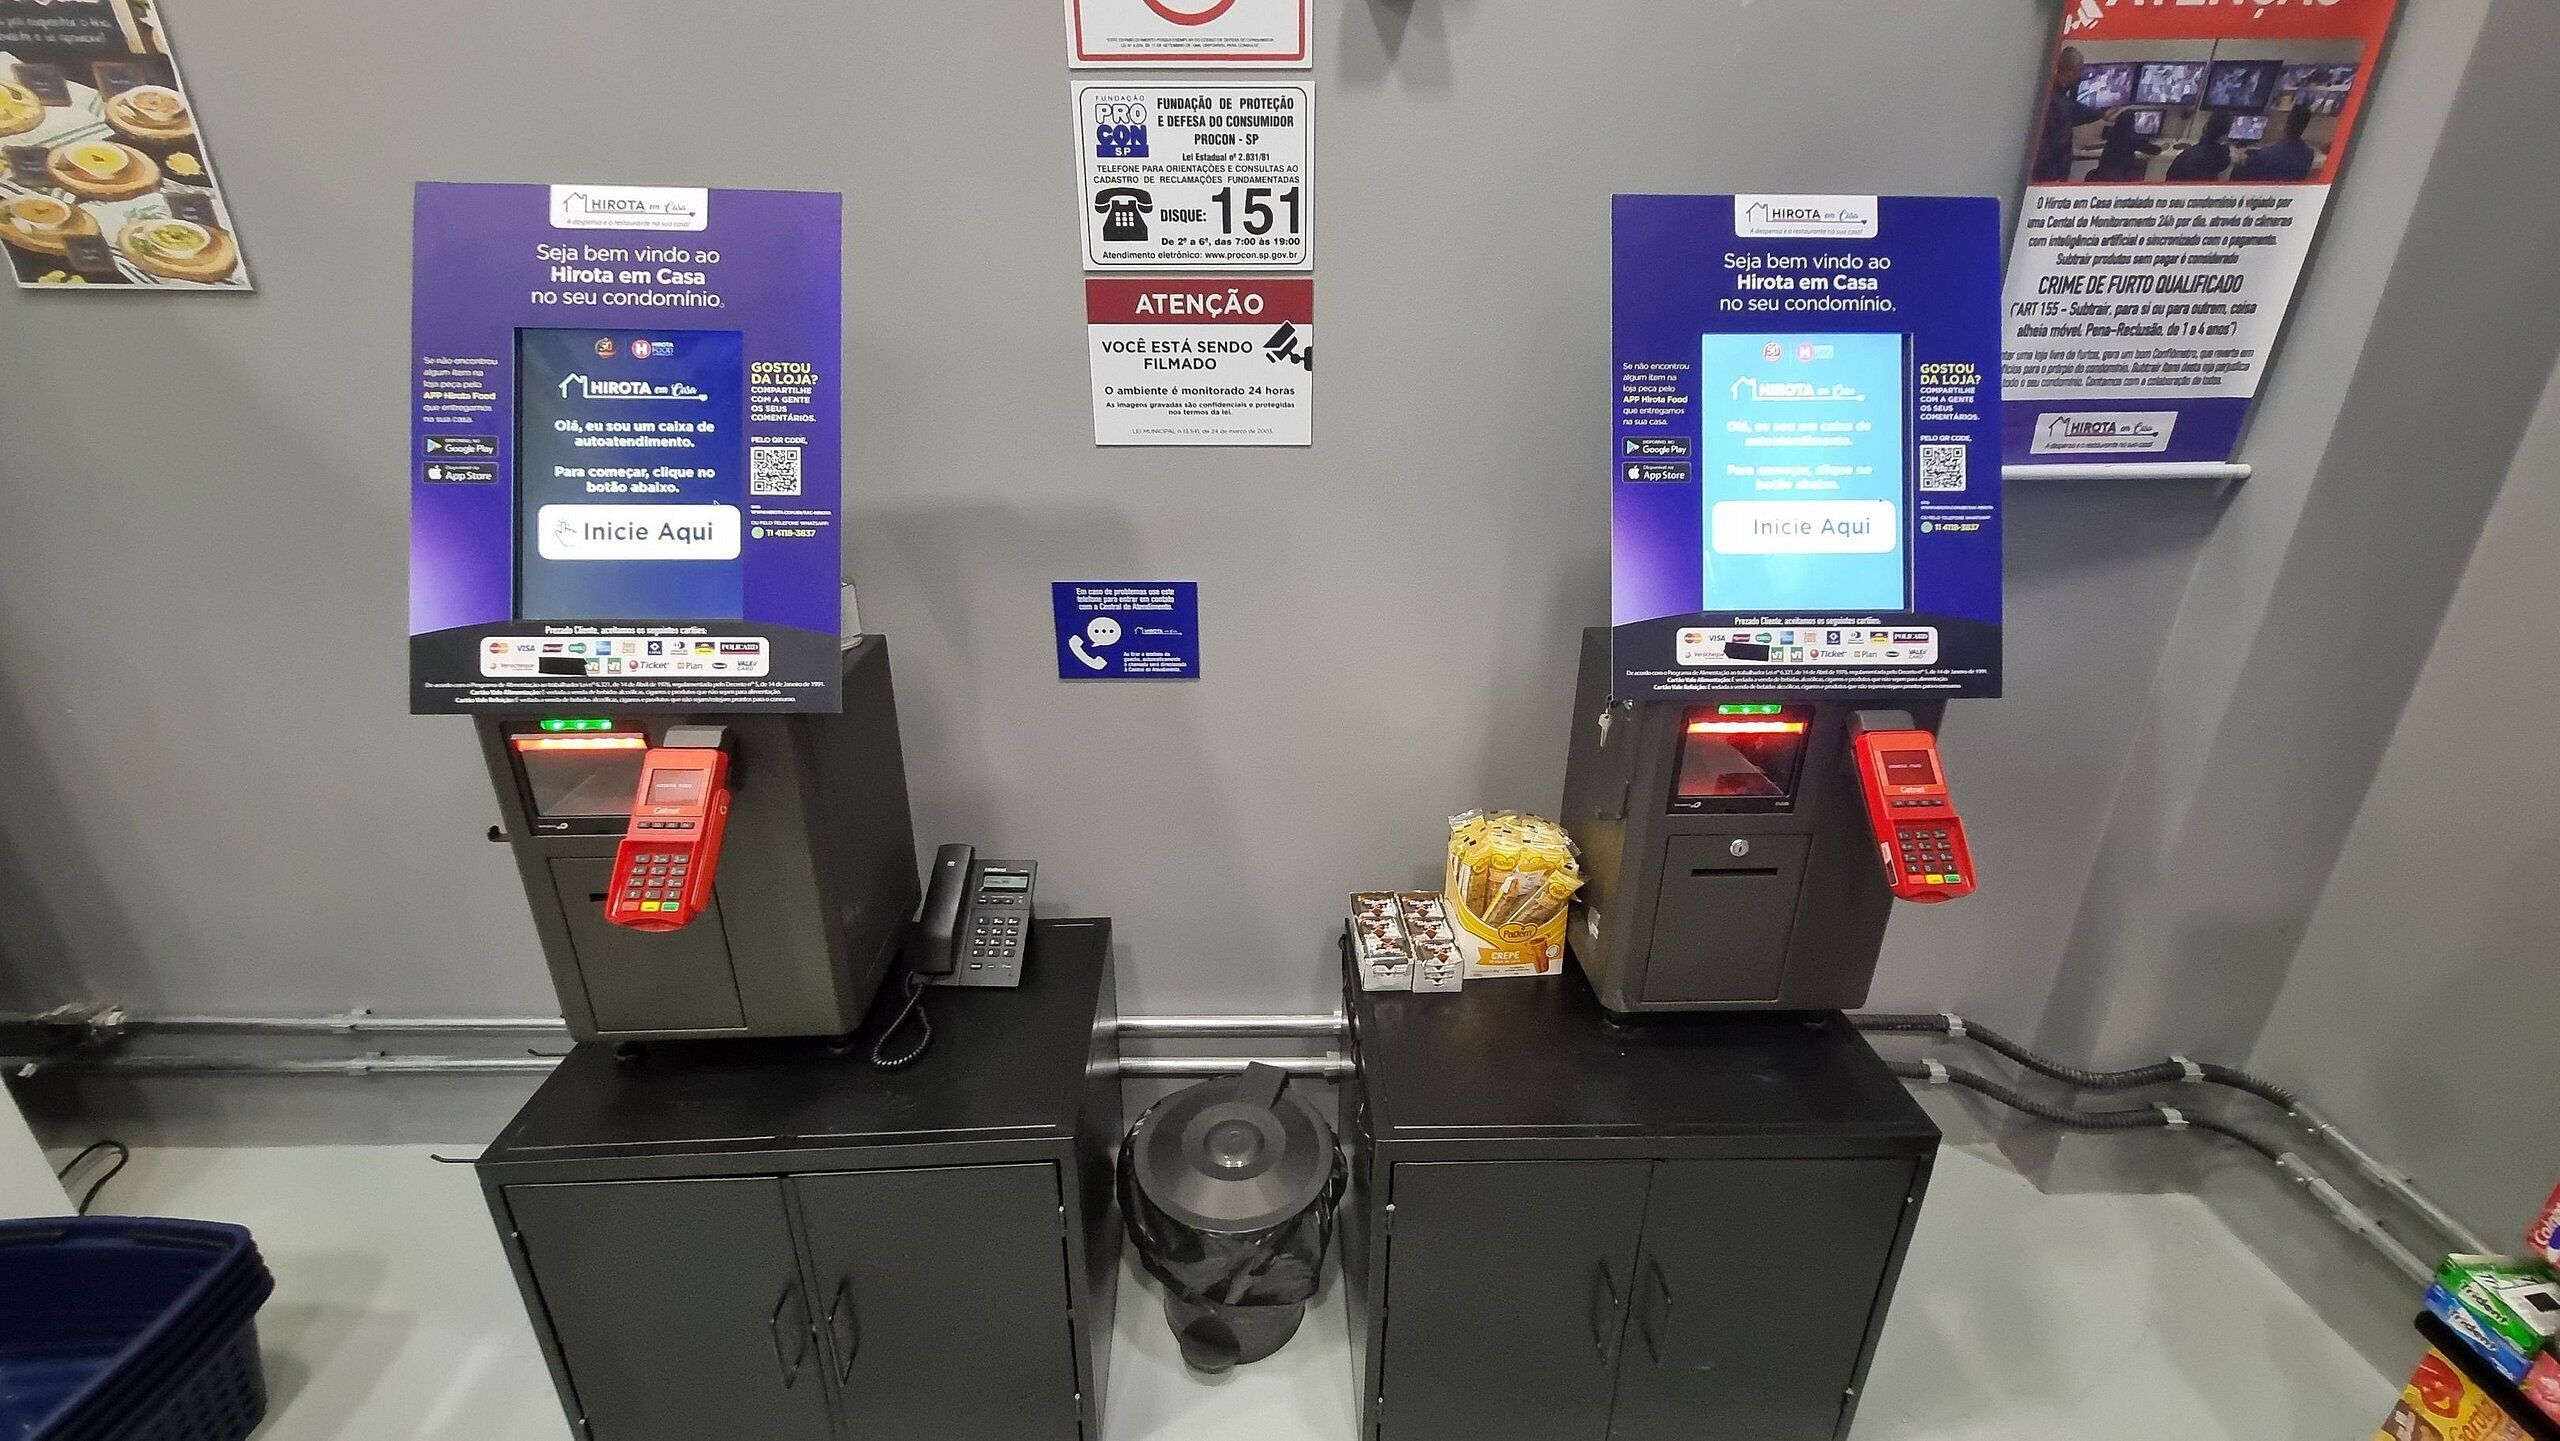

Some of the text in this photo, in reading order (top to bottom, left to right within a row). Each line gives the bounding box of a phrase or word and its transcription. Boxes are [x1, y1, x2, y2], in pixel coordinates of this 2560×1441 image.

[1095, 94, 1145, 102] FUNDAÇÃO
[1157, 95, 1294, 113] FUNDAÇÃO DE PROTEÇÃO
[1095, 103, 1147, 125] PRO
[1158, 116, 1294, 128] E DEFESA DO CONSUMIDOR
[1097, 124, 1147, 145] CON
[1194, 134, 1259, 146] PROCON SP
[1115, 147, 1131, 156] SP
[1182, 153, 1194, 162] Lei
[1195, 153, 1227, 162] Estadual
[1097, 163, 1299, 175] TELEFONE PARA ORIENTAÇÕES E CONSULTAS AO
[1093, 174, 1300, 185] CADASTRO DE RECLAMAÇÕES FUNDAMENTADAS
[592, 199, 645, 211] HIROTA
[664, 201, 687, 213] Casa
[1212, 187, 1299, 235] 151
[1160, 209, 1207, 223] DISQUE:
[1772, 208, 1821, 219] HIROTA
[1161, 237, 1175, 246] De
[1214, 237, 1232, 246] das
[1234, 237, 1256, 246] 7:00
[1258, 237, 1271, 246] às
[1273, 237, 1301, 246] 19:00
[536, 243, 721, 266] Seja bem vindo ao
[1102, 251, 1298, 261] Atendimento eletrônico: www.procon.sp.gov.br
[1724, 253, 1891, 272] Seja bem vindo ao
[551, 266, 706, 286] Hirota em Casa
[1737, 274, 1878, 291] Hirota em Casa
[2038, 274, 2244, 295] CRIME DE FURTO QUALIFICADO
[531, 289, 725, 309] no seu condomínio.
[1135, 288, 1264, 319] ATENÇÃO
[1719, 294, 1896, 312] no seu condomínio.
[2041, 302, 2060, 316] 155
[1101, 338, 1253, 354] VOCÊ ESTÁ SENDO
[751, 362, 811, 374] GOSTOU
[1144, 357, 1217, 370] FILMADO
[1920, 363, 1975, 374] GOSTOU
[751, 374, 819, 385] DA LOJA?
[1920, 375, 1982, 385] DA LOJA?
[590, 381, 698, 397] HIROTA em Casa
[751, 386, 812, 395] COMPARTILHE
[1104, 385, 1296, 396] O ambiente é monitorado 24 horas
[782, 396, 811, 404] GENTE
[1105, 401, 1115, 409] As
[1117, 401, 1148, 410] imagens
[1149, 402, 1183, 410] gravadas
[1199, 401, 1247, 409] confidenciais
[1255, 401, 1295, 410] protegidas
[751, 405, 788, 413] OS SEUS
[1210, 408, 1220, 416] da
[1222, 408, 1233, 416] lei.
[751, 413, 817, 423] COMENTÁRIOS.
[1920, 412, 1980, 421] COMENTÁRIOS.
[554, 419, 715, 434] Olá, eu sou um caixa de
[2070, 422, 2117, 434] HIROTA
[574, 436, 696, 448] autoatendimento.
[1642, 445, 1687, 455] Google Play
[554, 466, 716, 481] Para começar, clique no
[1643, 471, 1686, 481] App Store
[586, 480, 680, 494] botão abaixo.
[584, 522, 714, 544] Inicie Aqui
[1754, 517, 1871, 538] Inicie Aqui
[1820, 650, 1846, 658] Ticket
[1861, 650, 1878, 658] Plan
[641, 661, 668, 669] Ticket
[686, 661, 703, 670] Plan
[1491, 951, 1520, 960] CREPE
[2461, 1281, 2509, 1325] Trident
[2451, 1309, 2497, 1351] Trident
